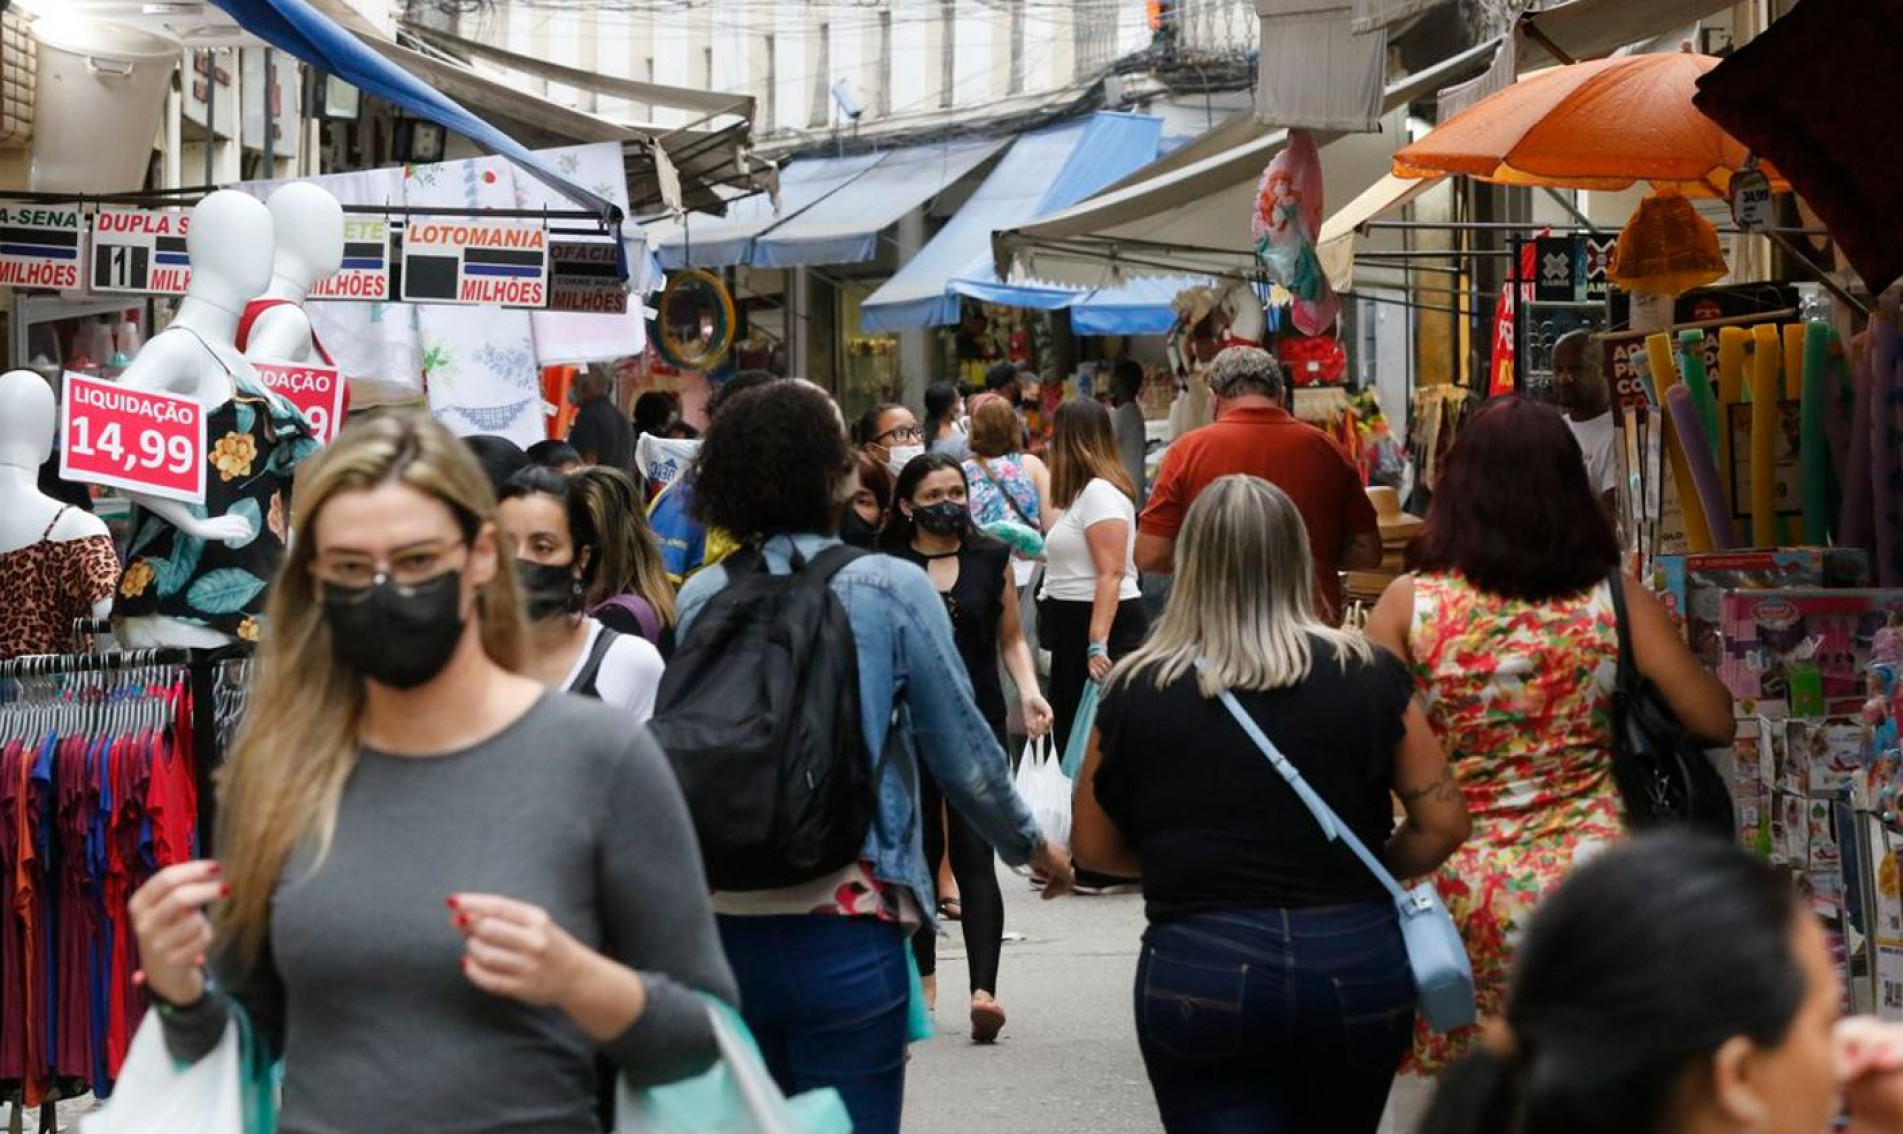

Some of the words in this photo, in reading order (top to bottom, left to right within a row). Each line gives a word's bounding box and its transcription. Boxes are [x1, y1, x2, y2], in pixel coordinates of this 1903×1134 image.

[97, 213, 170, 234] DUPLA
[408, 225, 544, 249] LOTOMANIA
[460, 277, 543, 304] MILHÕES
[74, 385, 194, 425] LIQUIDAÇÃO
[70, 415, 194, 475] 14,99
